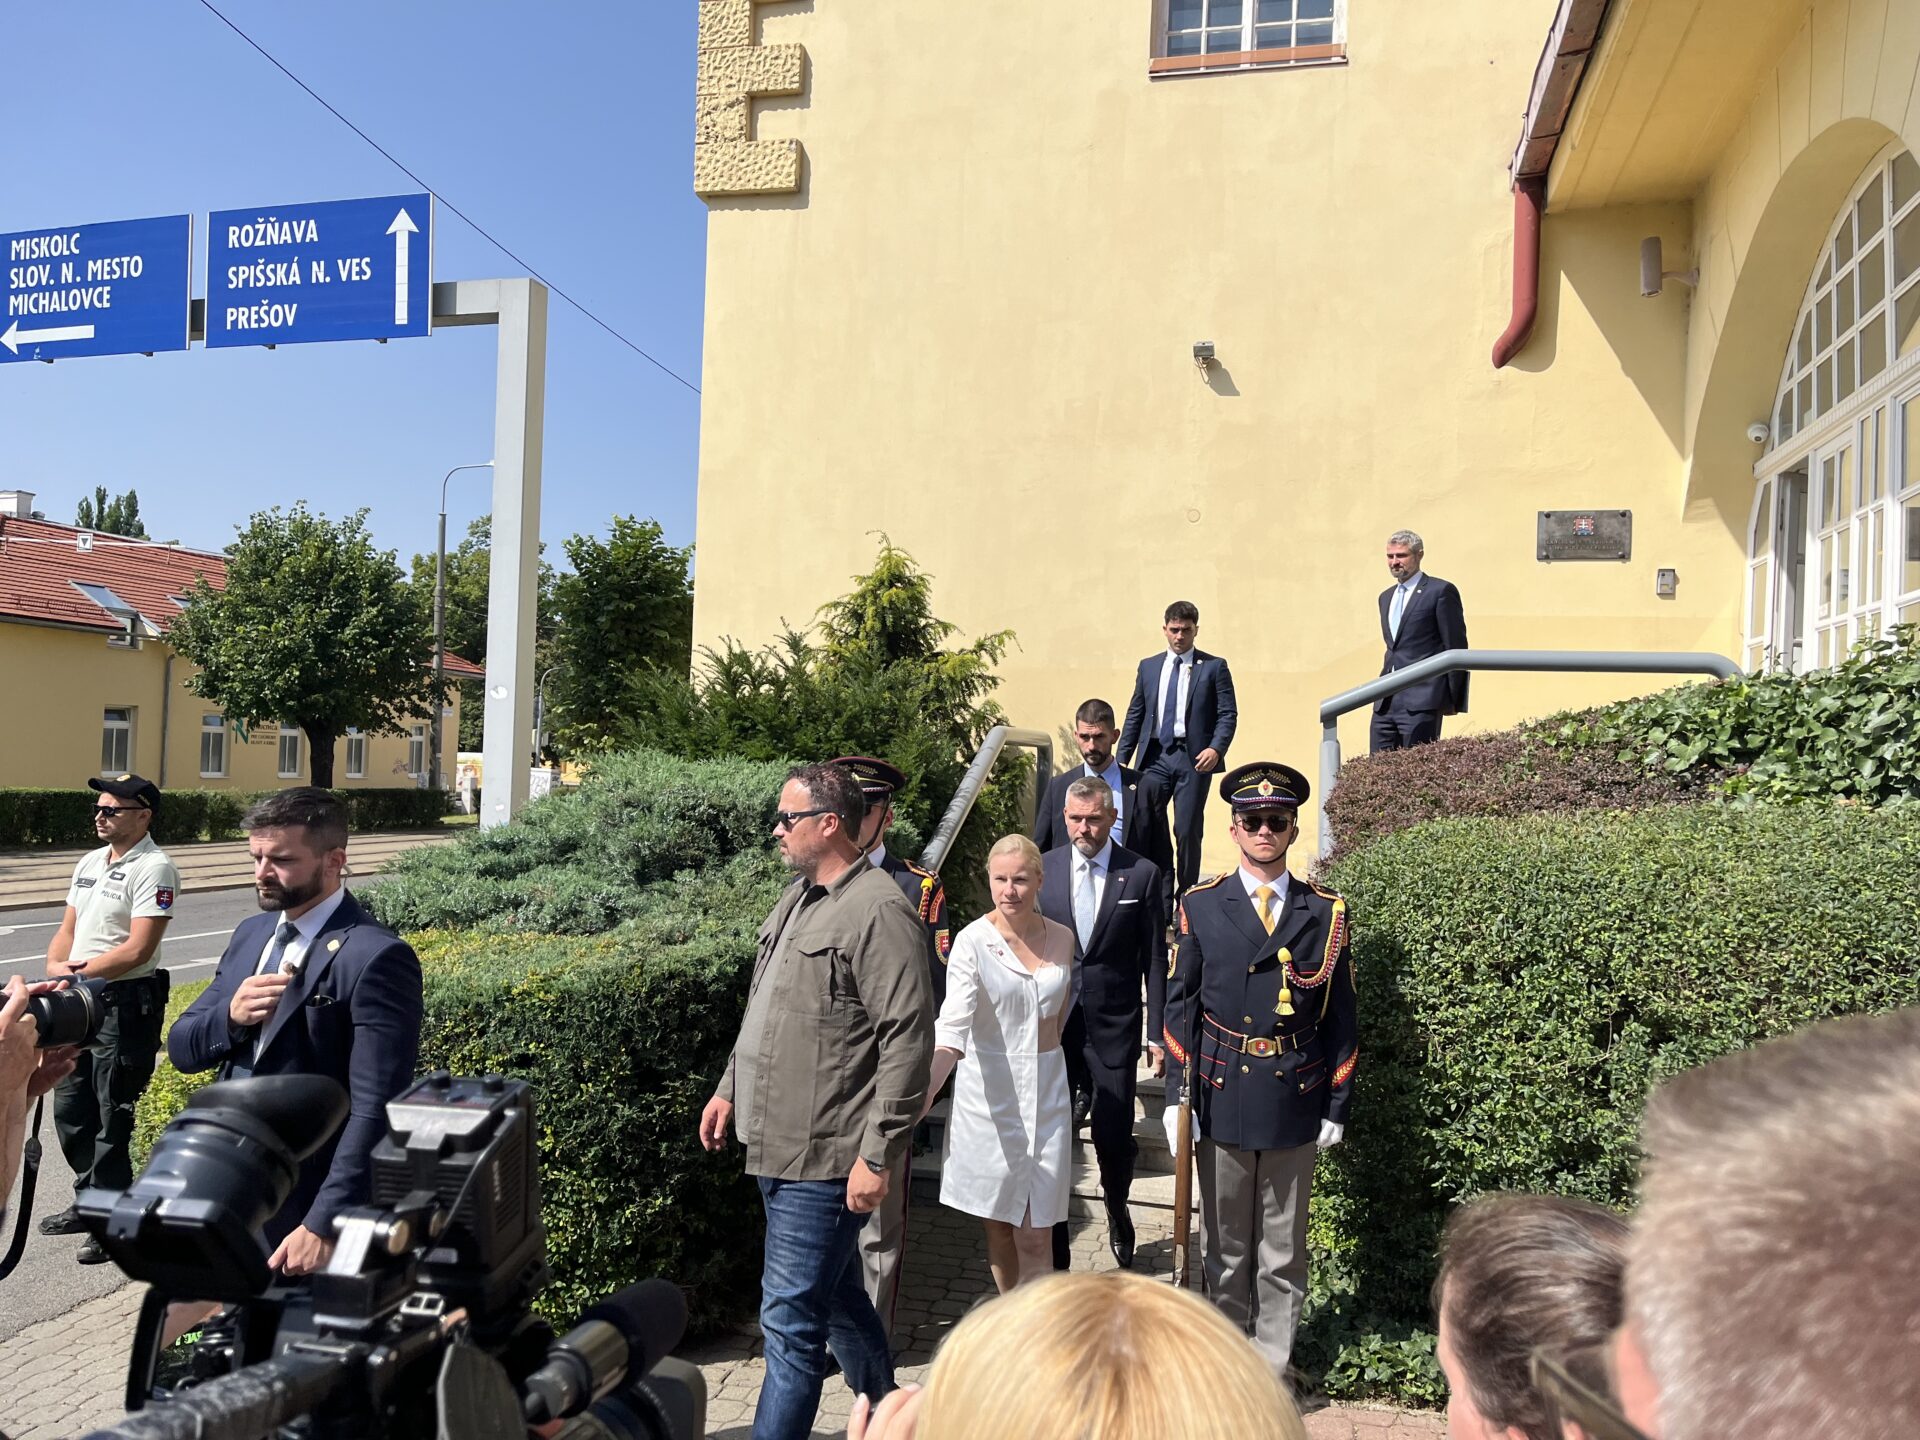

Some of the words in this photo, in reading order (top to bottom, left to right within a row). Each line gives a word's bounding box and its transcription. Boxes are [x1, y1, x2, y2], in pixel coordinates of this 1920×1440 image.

[11, 233, 80, 261] MISKOLC
[228, 217, 318, 248] ROŽŇAVA
[10, 264, 54, 289] SLOV.
[87, 256, 143, 281] MESTO
[228, 256, 301, 289] SPIŠSKÁ
[311, 260, 331, 283] N.
[337, 257, 371, 282] VES
[9, 286, 111, 316] MICHALOVCE
[226, 299, 297, 330] PREŠOV
